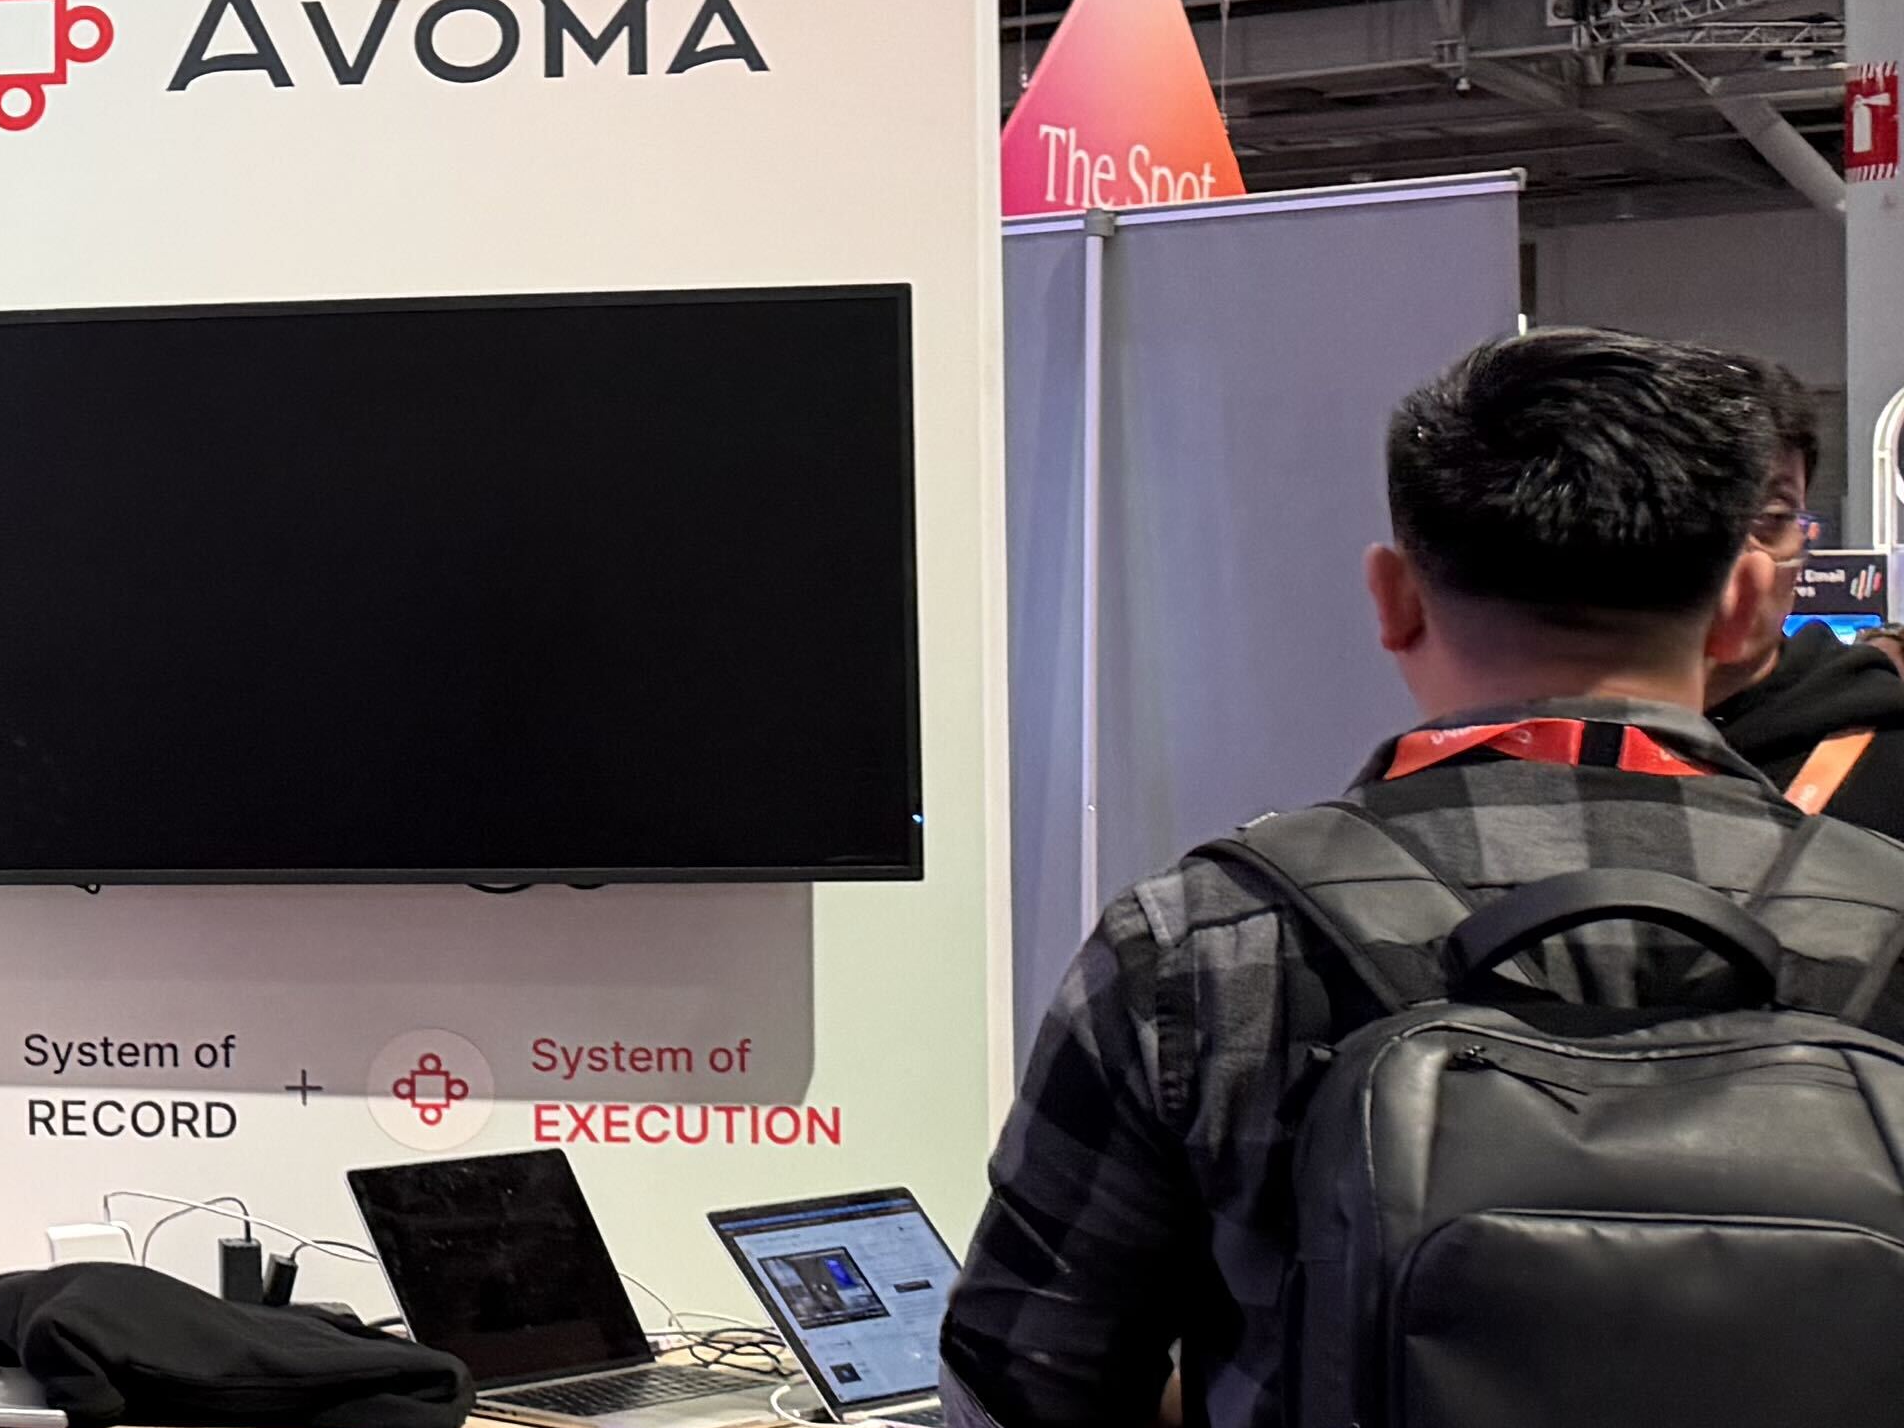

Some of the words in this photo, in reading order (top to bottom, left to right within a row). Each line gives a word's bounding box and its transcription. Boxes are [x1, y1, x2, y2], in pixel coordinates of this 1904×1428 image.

[1039, 124, 1116, 209] The
[25, 1034, 178, 1074] System
[195, 1035, 235, 1068] of
[533, 1038, 693, 1080] System
[709, 1039, 751, 1073] of
[29, 1100, 236, 1138] RECORD
[533, 1103, 841, 1146] EXECUTION
